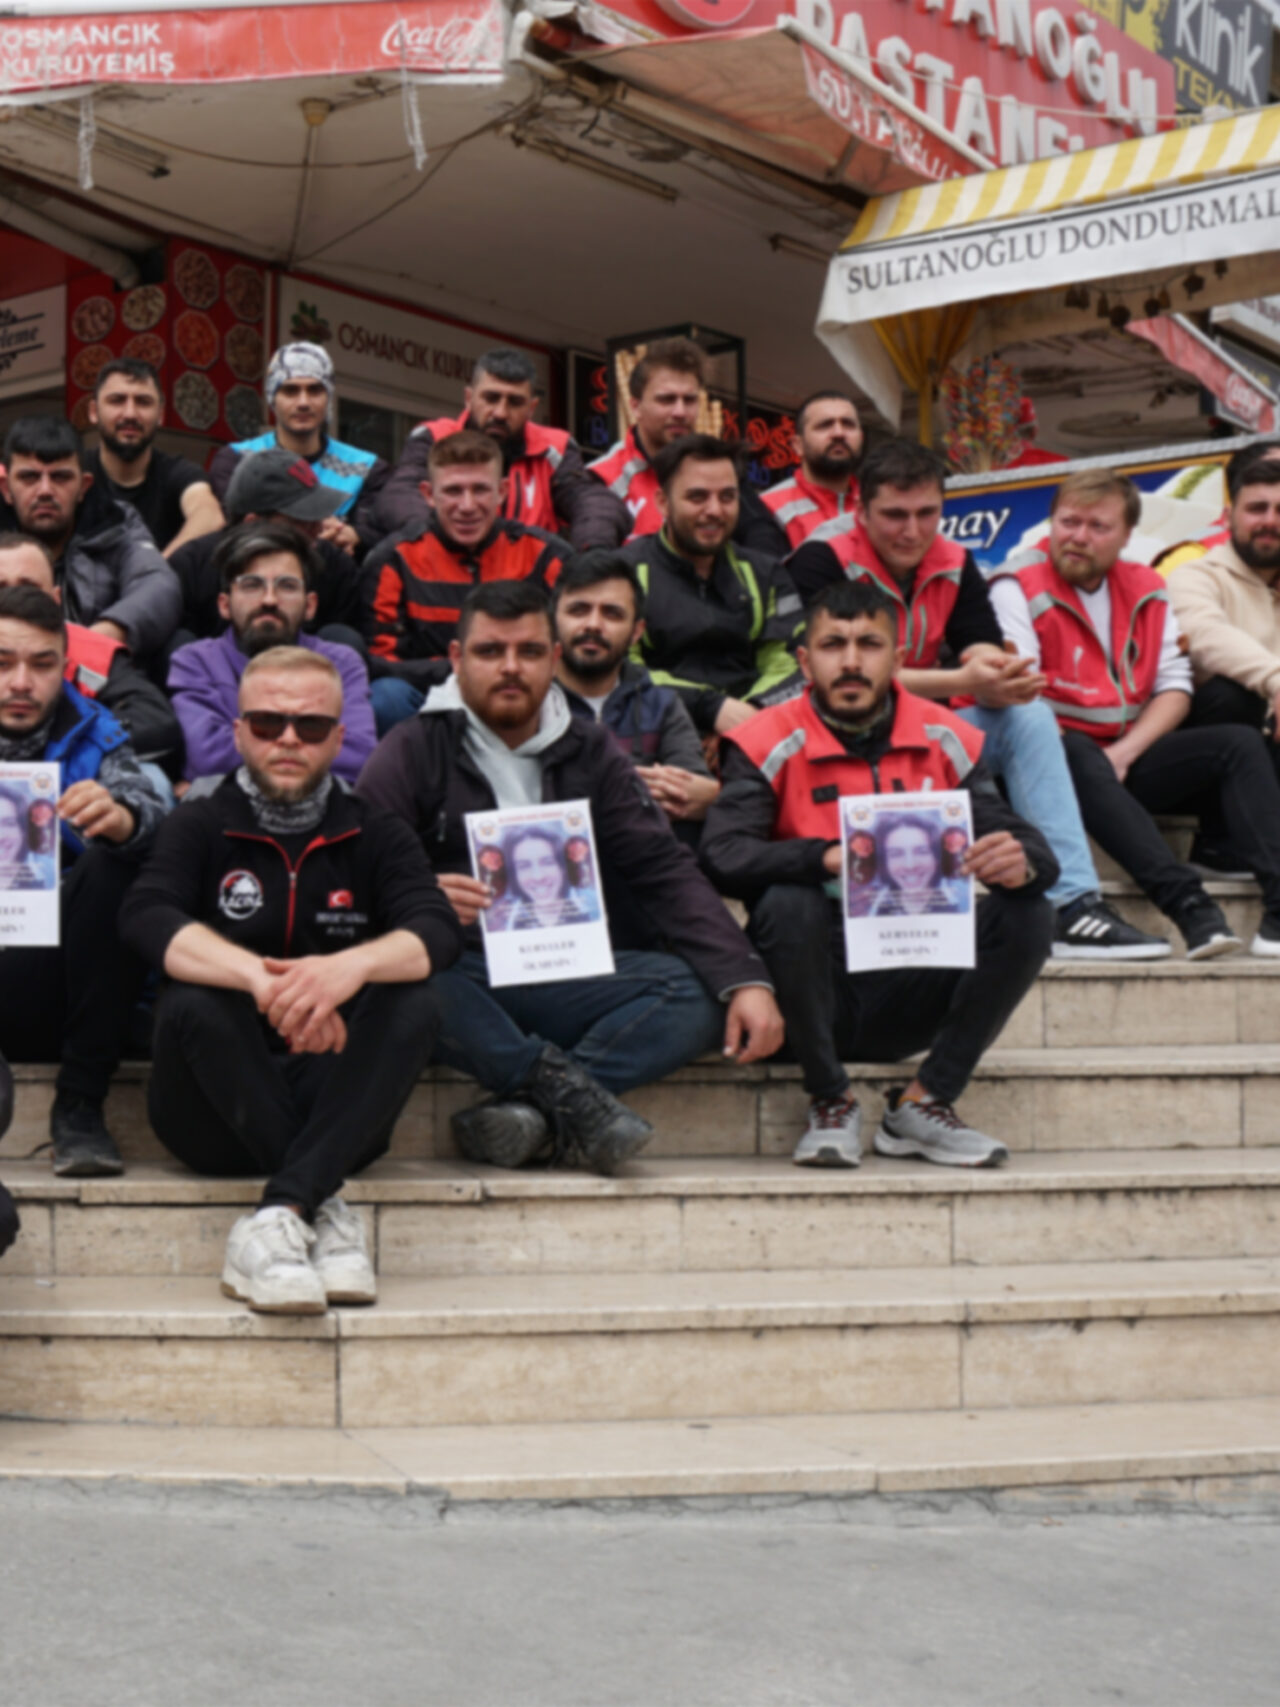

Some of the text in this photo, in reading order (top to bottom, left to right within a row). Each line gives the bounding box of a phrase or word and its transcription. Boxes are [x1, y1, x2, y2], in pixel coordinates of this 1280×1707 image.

[2, 21, 161, 52] OSMANCIK
[2, 50, 175, 76] KURUYEMİŞ
[847, 230, 1047, 295] SULTANOĞLU
[338, 321, 429, 372] OSMANCIK
